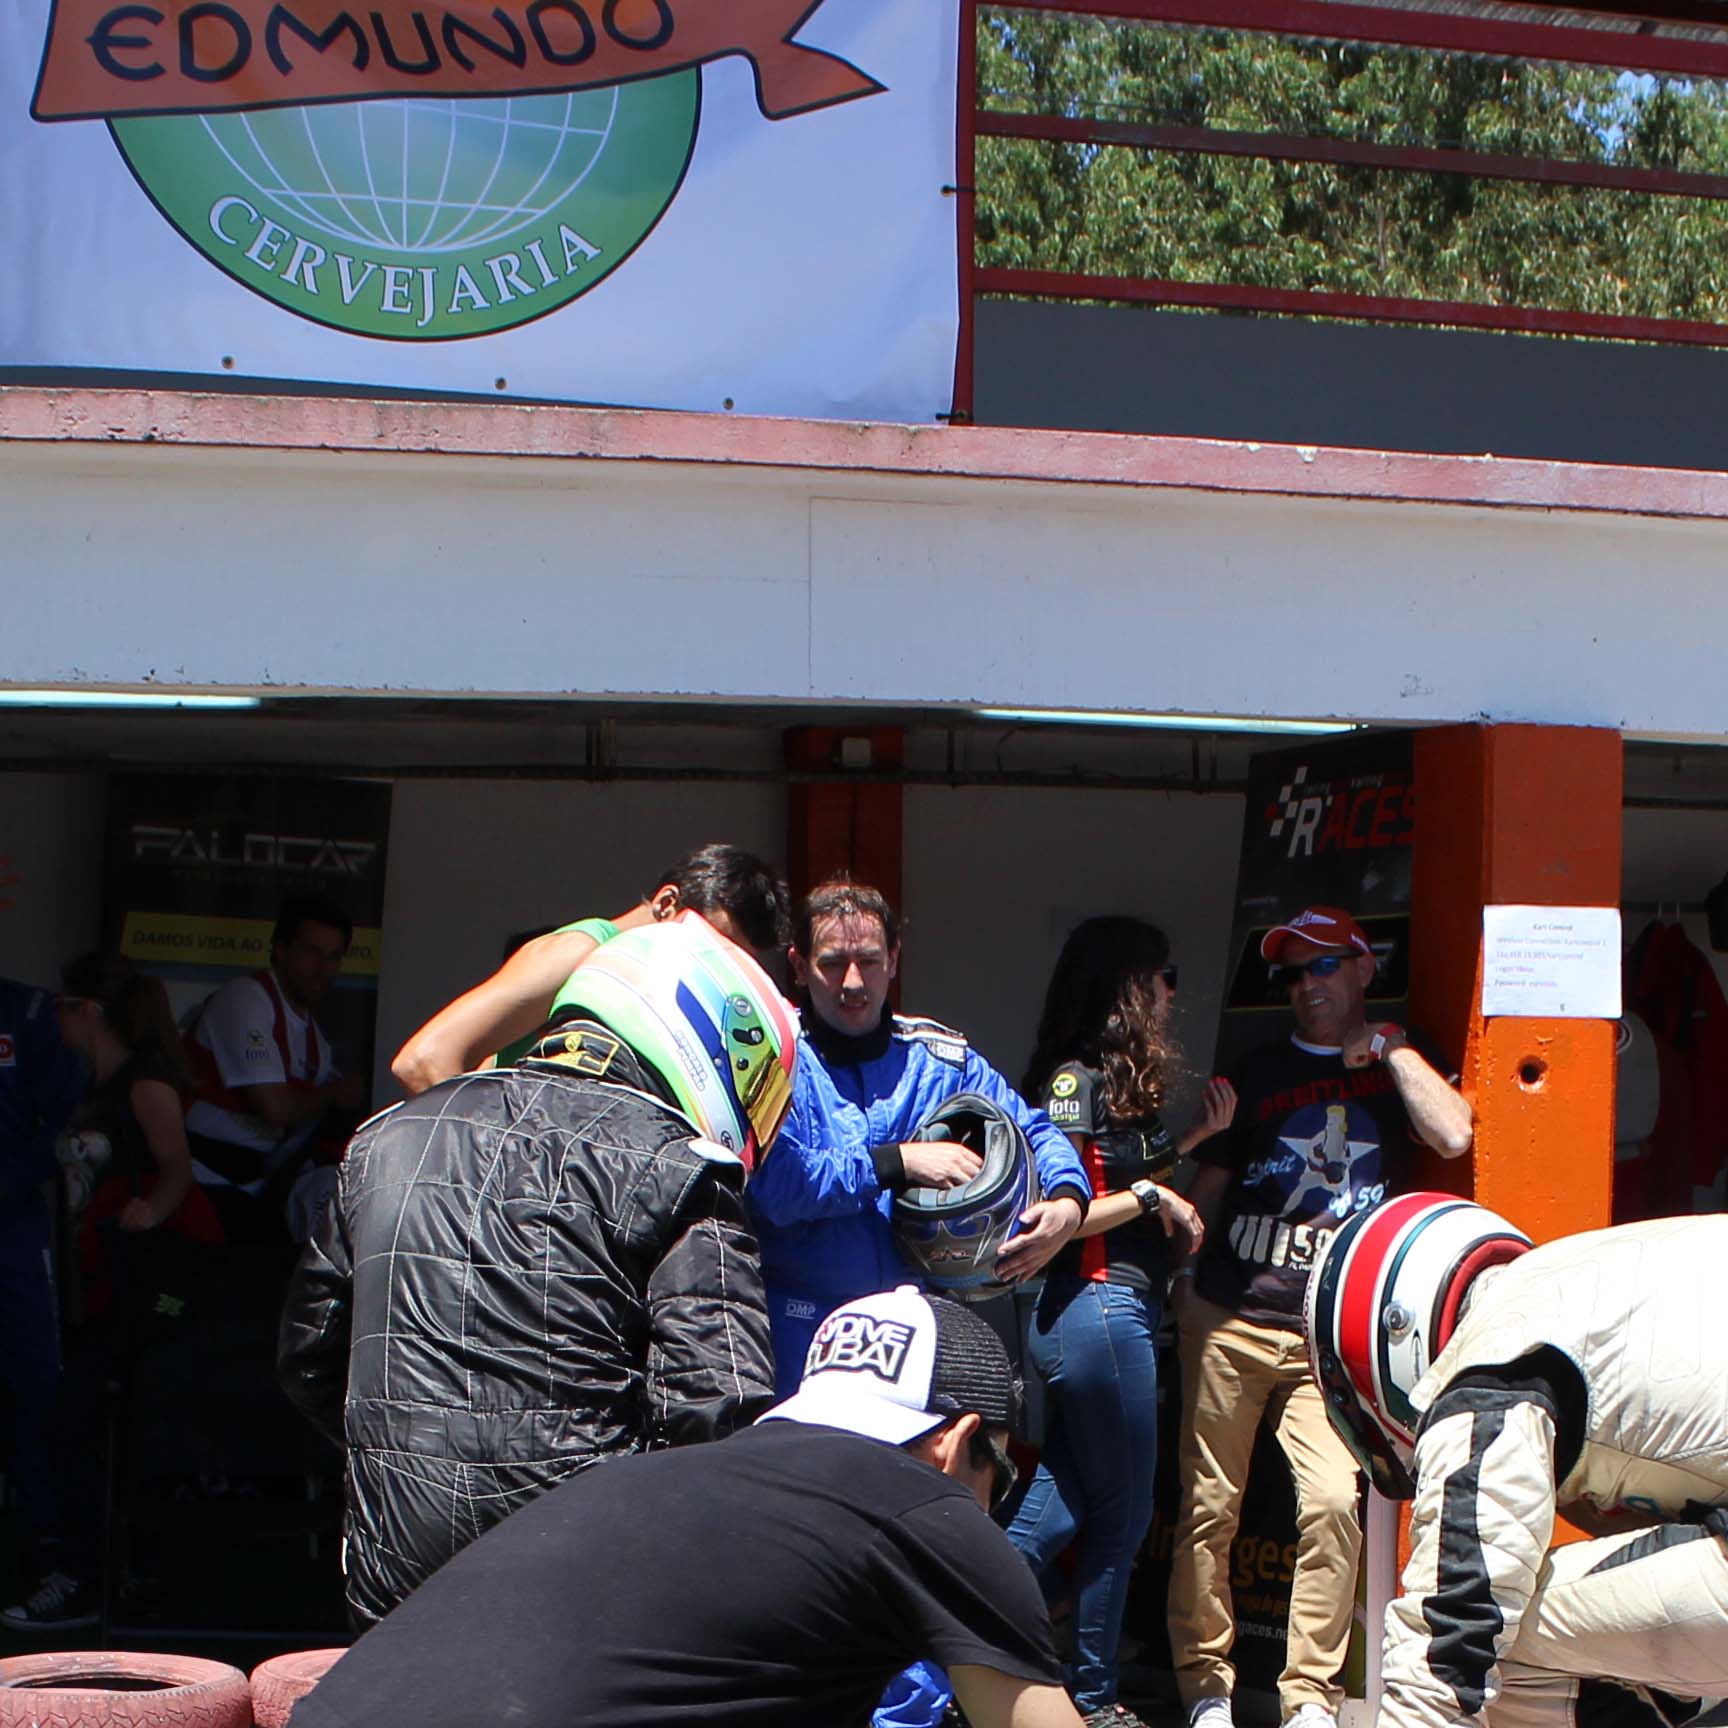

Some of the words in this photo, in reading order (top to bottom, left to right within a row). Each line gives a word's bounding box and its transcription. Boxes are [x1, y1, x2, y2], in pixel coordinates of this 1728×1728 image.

[86, 0, 675, 83] EDMUNDO
[207, 194, 603, 328] CERVEJARIA
[785, 1302, 817, 1317] OMP
